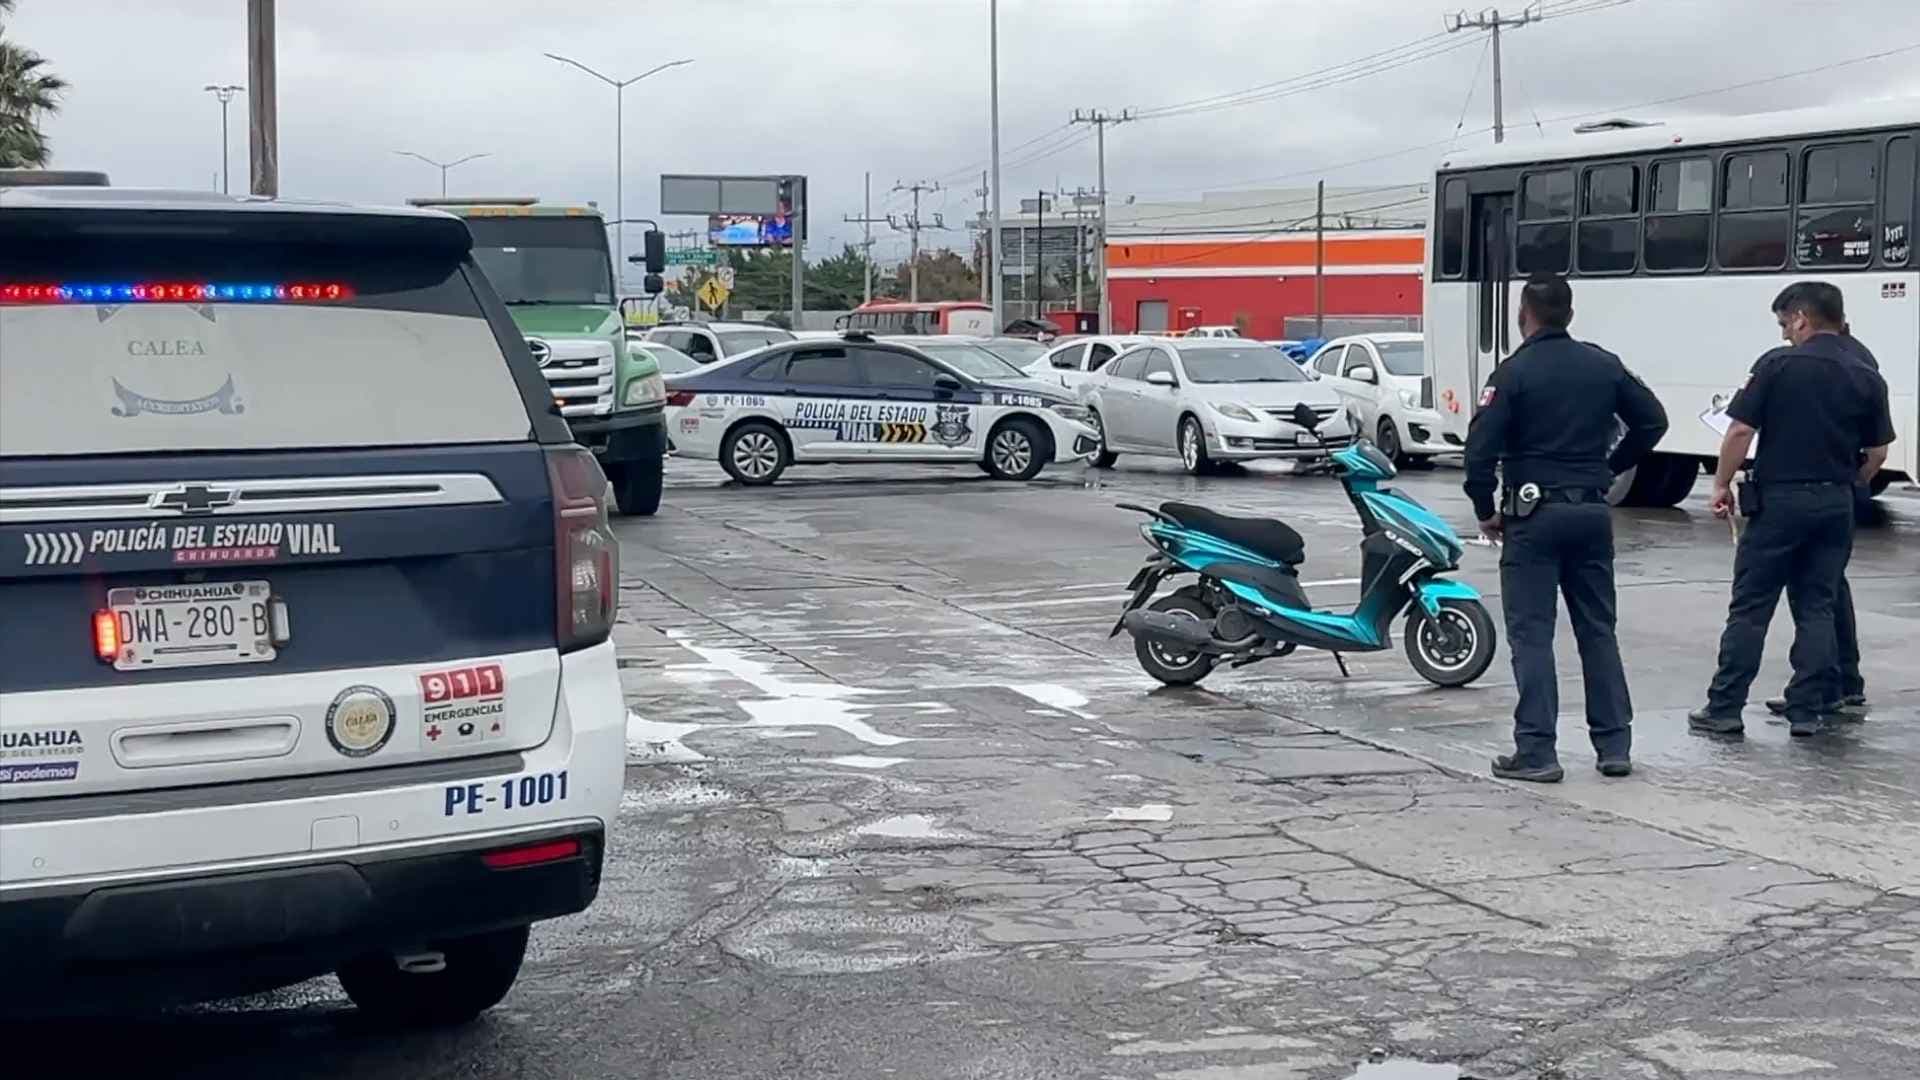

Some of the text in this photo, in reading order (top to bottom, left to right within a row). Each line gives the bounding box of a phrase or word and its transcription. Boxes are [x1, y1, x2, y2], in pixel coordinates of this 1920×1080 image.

[127, 340, 206, 356] CALEA
[850, 404, 874, 421] DEL
[878, 405, 927, 423] ESTADO
[843, 422, 878, 442] VIAL
[90, 522, 341, 555] POLICÍA DEL ESTADO VIAL
[175, 548, 278, 561] CHIHUAHUA
[148, 585, 233, 600] CHIHUAHUA
[118, 603, 269, 645] DWA-280-B
[425, 668, 502, 700] 911
[423, 703, 504, 724] EMERGENCIAS
[0, 729, 83, 748] UAHUA
[39, 746, 85, 756] ESTADO
[13, 765, 76, 782] podemos
[444, 770, 568, 817] PE-1001
